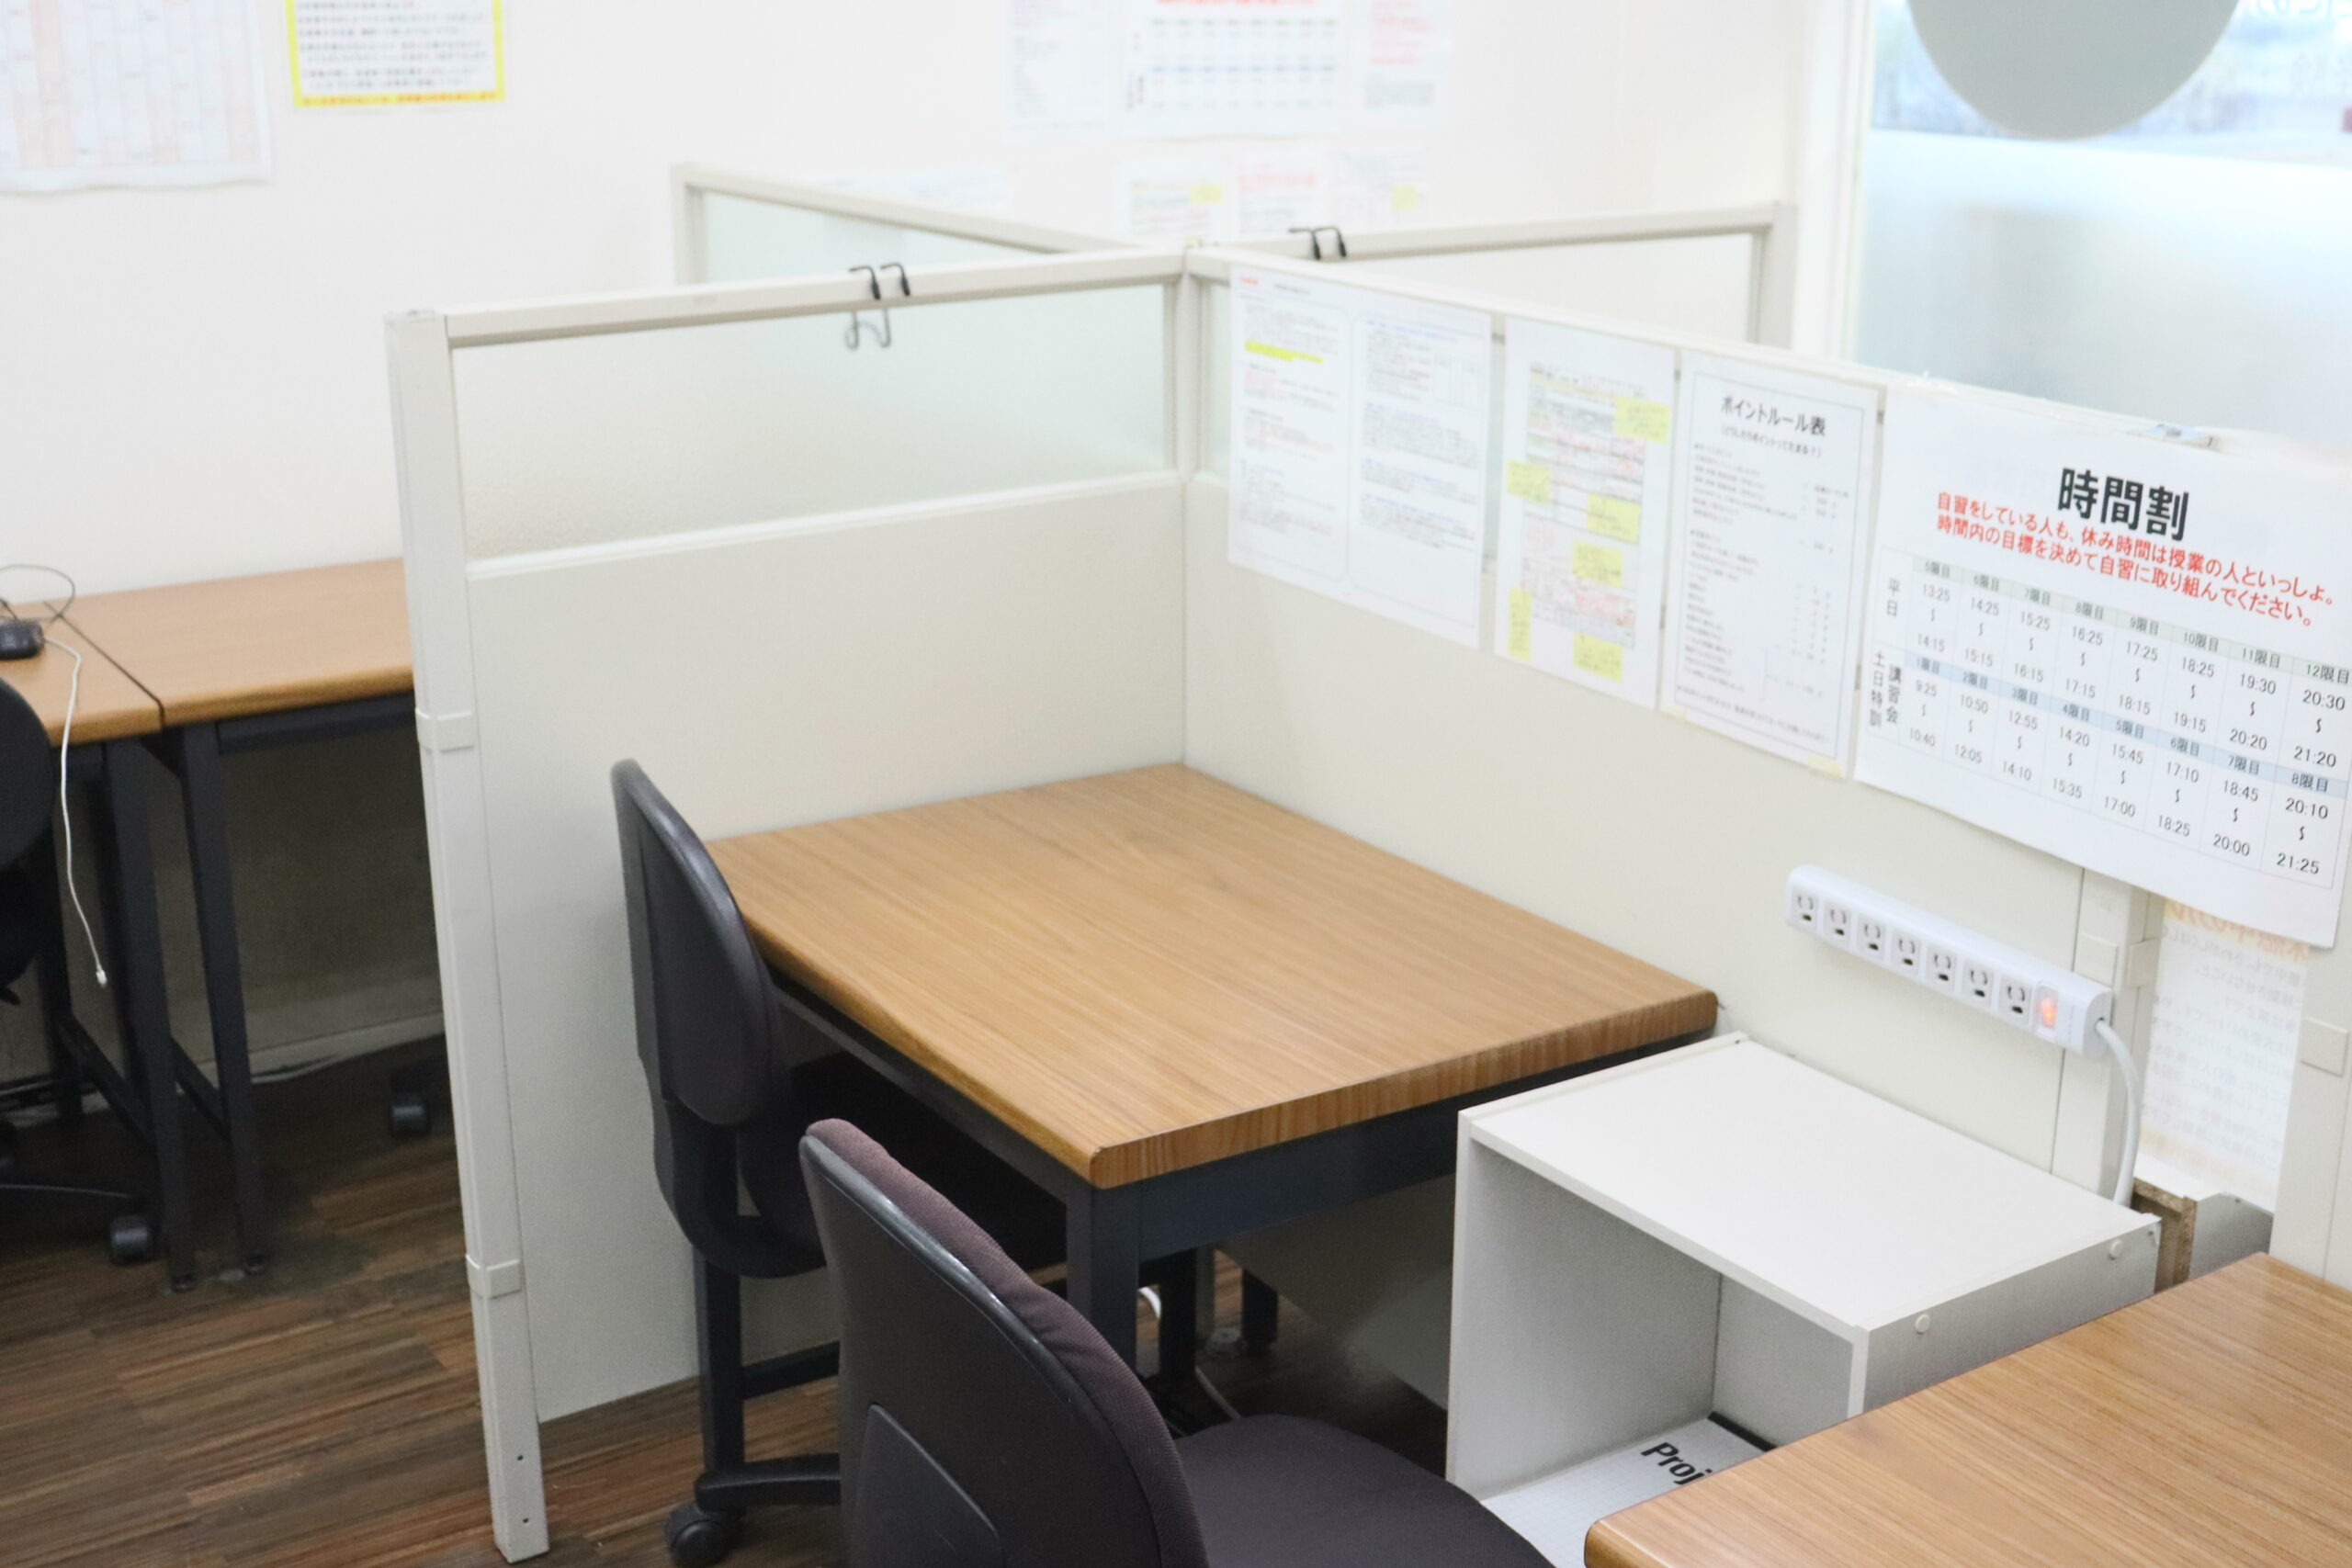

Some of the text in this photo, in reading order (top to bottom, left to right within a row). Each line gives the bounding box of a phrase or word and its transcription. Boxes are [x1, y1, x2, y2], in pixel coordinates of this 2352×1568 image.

[1721, 397, 1826, 437] ポイントルール表
[2058, 467, 2189, 542] 時間割
[1937, 491, 2334, 606] 自習をしている人も、休み時間は授業の人といっしょ。
[1937, 513, 2312, 627] 時間内の目標を決めて自習に取り組んでください。
[1887, 578, 1900, 617] 平日
[1923, 583, 1950, 603] 13:25
[1972, 597, 1999, 616] 14:25
[2020, 612, 2050, 630] 15:25
[1918, 634, 1944, 652] 14:15
[2073, 626, 2102, 646] 16:25
[2183, 632, 2218, 652] 10限目
[1965, 649, 1994, 667] 15:15
[2127, 641, 2157, 661] 17:25
[2242, 648, 2280, 669] 11限目
[2014, 663, 2043, 682] 16:15
[2182, 658, 2214, 678] 18:25
[2306, 664, 2350, 684] 12限目
[1917, 680, 1937, 698] 9:25
[2066, 678, 2095, 698] 17:15
[2240, 674, 2276, 694] 19:30
[1961, 694, 1988, 714] 10:50
[2119, 694, 2150, 715] 18:15
[2302, 689, 2346, 711] 20:30
[2008, 710, 2038, 729] 12:55
[2174, 712, 2206, 733] 19:15
[1909, 728, 1936, 748] 10:40
[2060, 727, 2089, 747] 14:20
[2230, 729, 2267, 750] 20:20
[1955, 744, 1982, 764] 12:05
[2112, 744, 2143, 764] 15:45
[2170, 739, 2199, 757] 6限目
[2294, 747, 2336, 768] 21:20
[2003, 761, 2031, 781] 14:10
[2166, 761, 2199, 783] 17:10
[2229, 755, 2260, 775] 7限目
[2052, 775, 2082, 799] 15:35
[2223, 780, 2258, 802] 18:45
[2292, 773, 2328, 793] 8限目
[2104, 795, 2135, 818] 17:00
[2286, 797, 2328, 819] 20:10
[2159, 815, 2190, 837] 18:25
[2213, 834, 2250, 856] 20:00
[2277, 852, 2319, 874] 21:25
[1641, 1442, 1713, 1484] Proj
